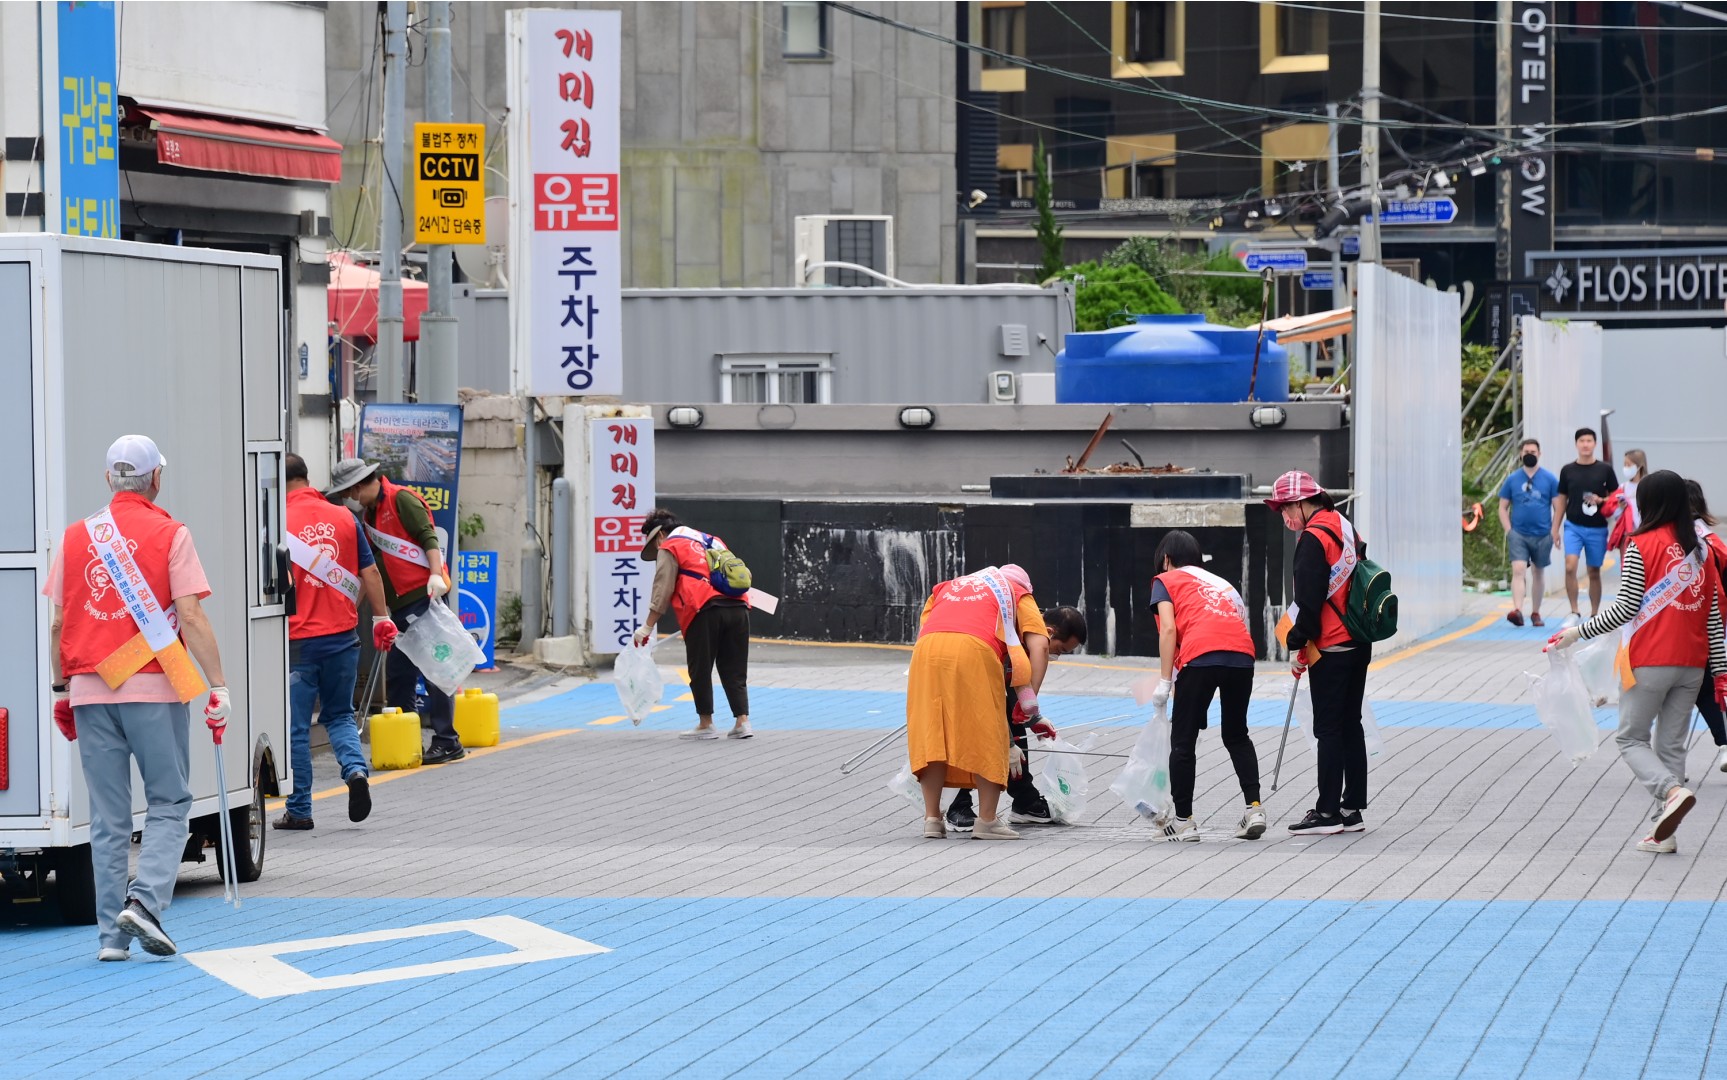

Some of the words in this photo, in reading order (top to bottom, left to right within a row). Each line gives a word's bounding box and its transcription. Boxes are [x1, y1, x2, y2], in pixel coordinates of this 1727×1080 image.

[1521, 0, 1547, 104] OTEL
[554, 28, 594, 158] 개미집
[62, 75, 115, 165] 구남로
[423, 156, 475, 178] CCTV
[1521, 122, 1547, 216] WOW
[538, 176, 615, 229] 유료
[419, 216, 450, 234] 24시간
[453, 219, 482, 235] 단속중
[1578, 264, 1648, 302] FLOS
[557, 247, 600, 390] 주차장
[373, 417, 410, 427] 하이엔드
[608, 424, 638, 510] 개미집
[299, 522, 336, 542] 1365
[597, 518, 648, 551] 유료
[466, 571, 490, 584] 확보
[467, 554, 490, 568] 금지
